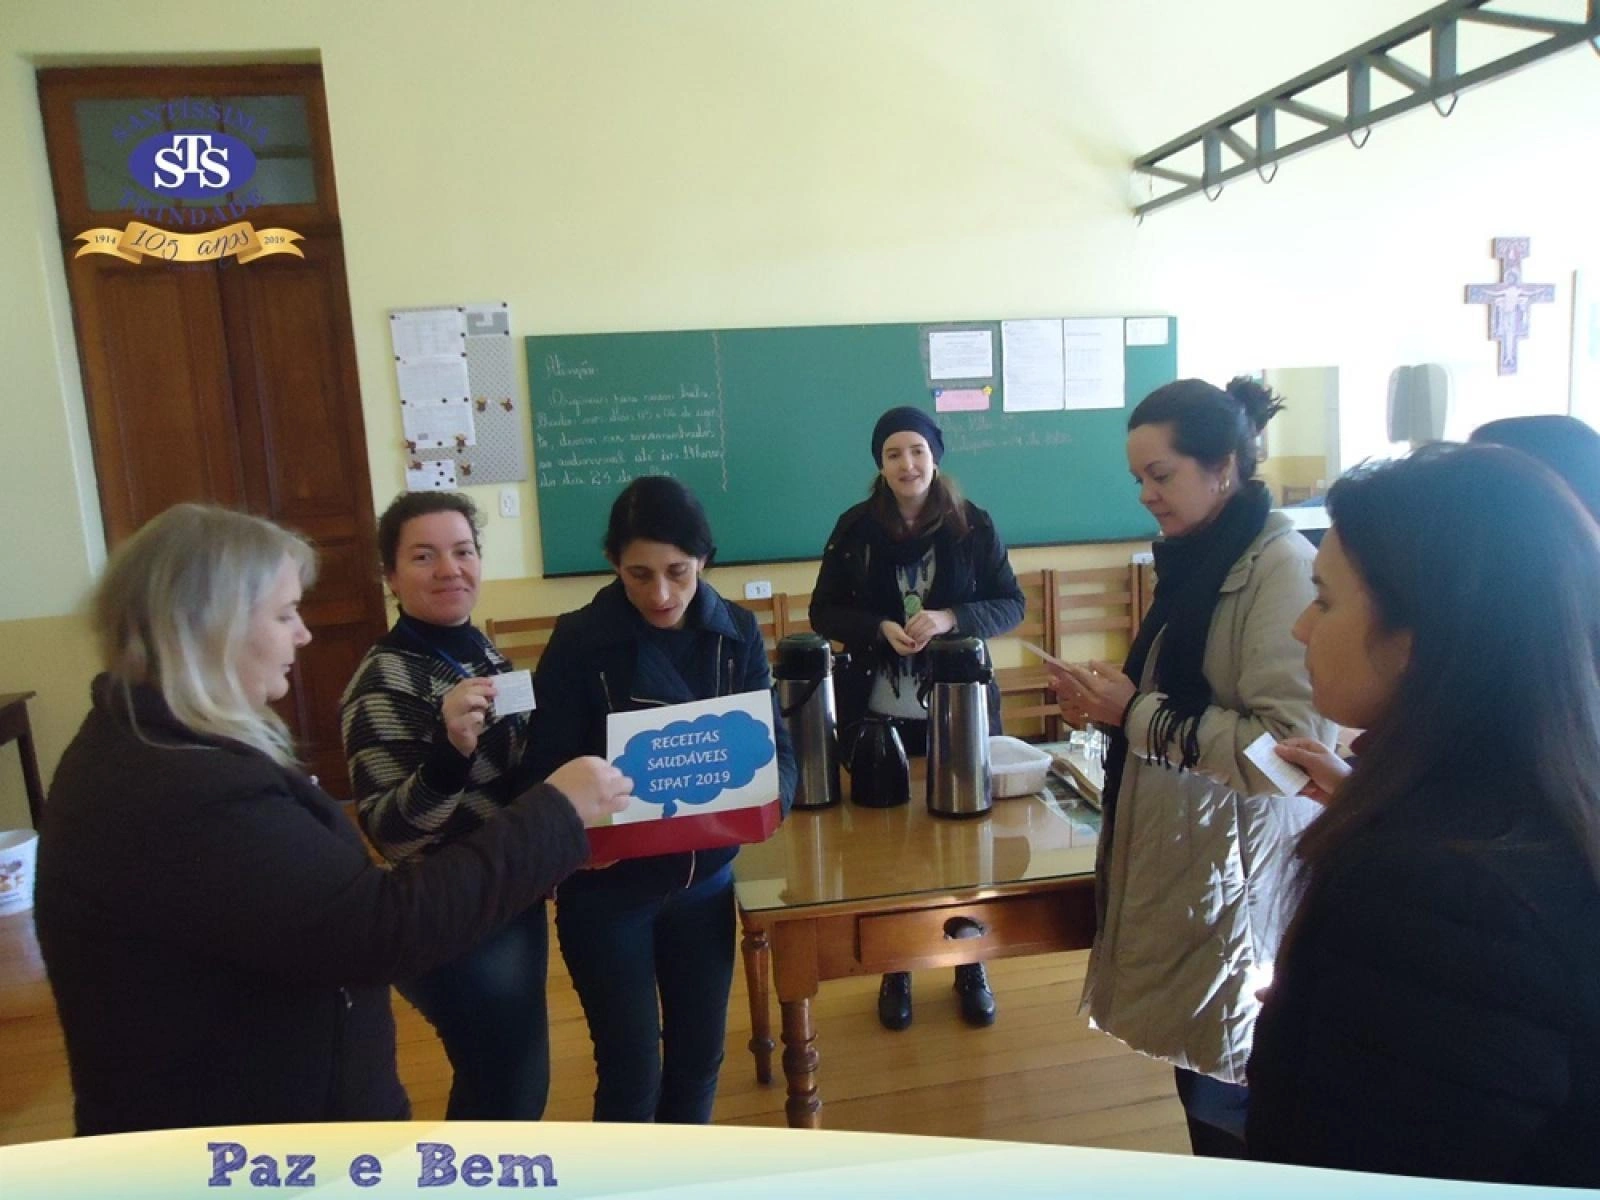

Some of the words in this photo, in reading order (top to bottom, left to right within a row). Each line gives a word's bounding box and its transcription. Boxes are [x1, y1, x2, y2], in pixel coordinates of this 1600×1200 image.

[651, 730, 720, 750] RECEITAS
[647, 749, 729, 771] SAUDÁVEIS
[650, 774, 693, 792] SIPAT
[695, 770, 731, 785] 2019
